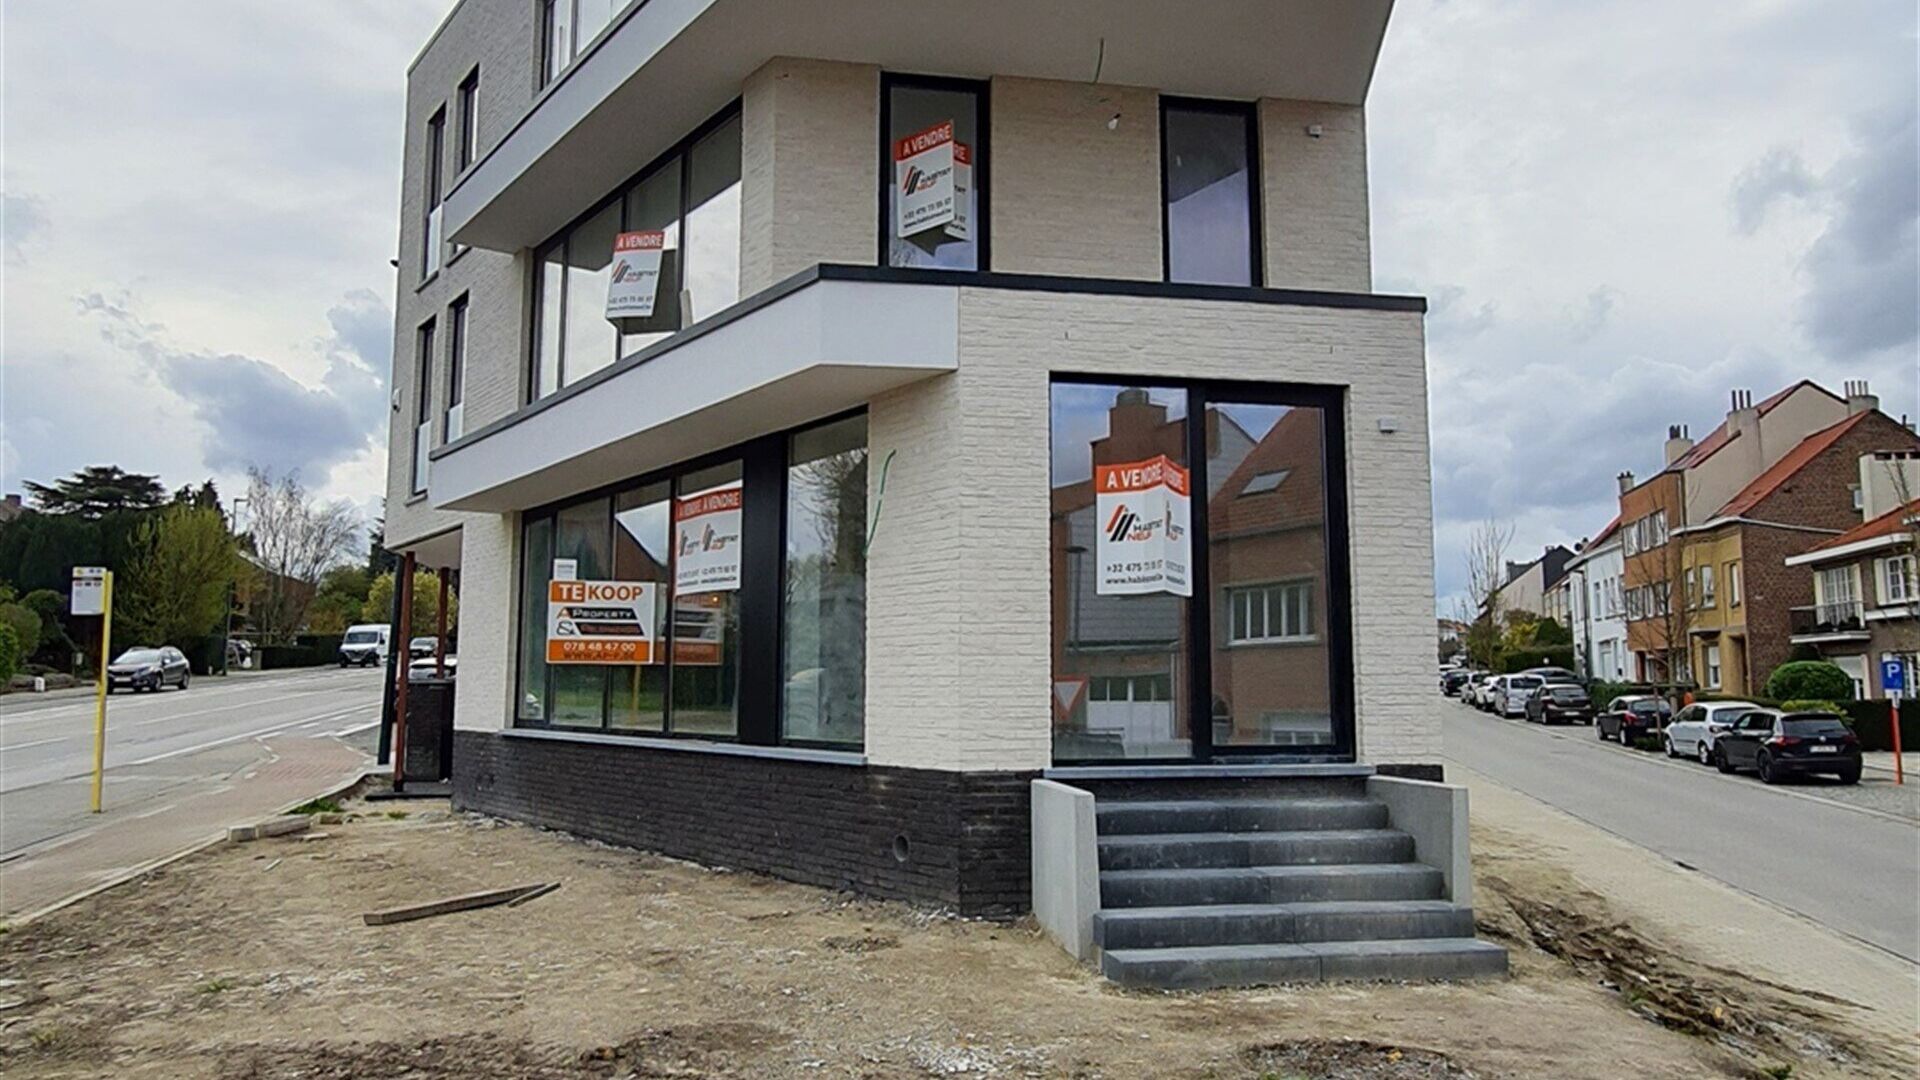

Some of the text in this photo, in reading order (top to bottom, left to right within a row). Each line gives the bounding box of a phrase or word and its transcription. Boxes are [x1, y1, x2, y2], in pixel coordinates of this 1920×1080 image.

[903, 141, 911, 156] A
[911, 124, 952, 152] VENDRE
[626, 234, 663, 247] VENDRE
[1107, 471, 1118, 488] A
[1121, 463, 1162, 487] VENDRE
[1107, 563, 1123, 573] +32
[1126, 563, 1142, 572] 475
[559, 584, 643, 600] TE KOOP
[605, 642, 619, 651] 47
[621, 642, 636, 652] 00
[1887, 663, 1900, 679] P
